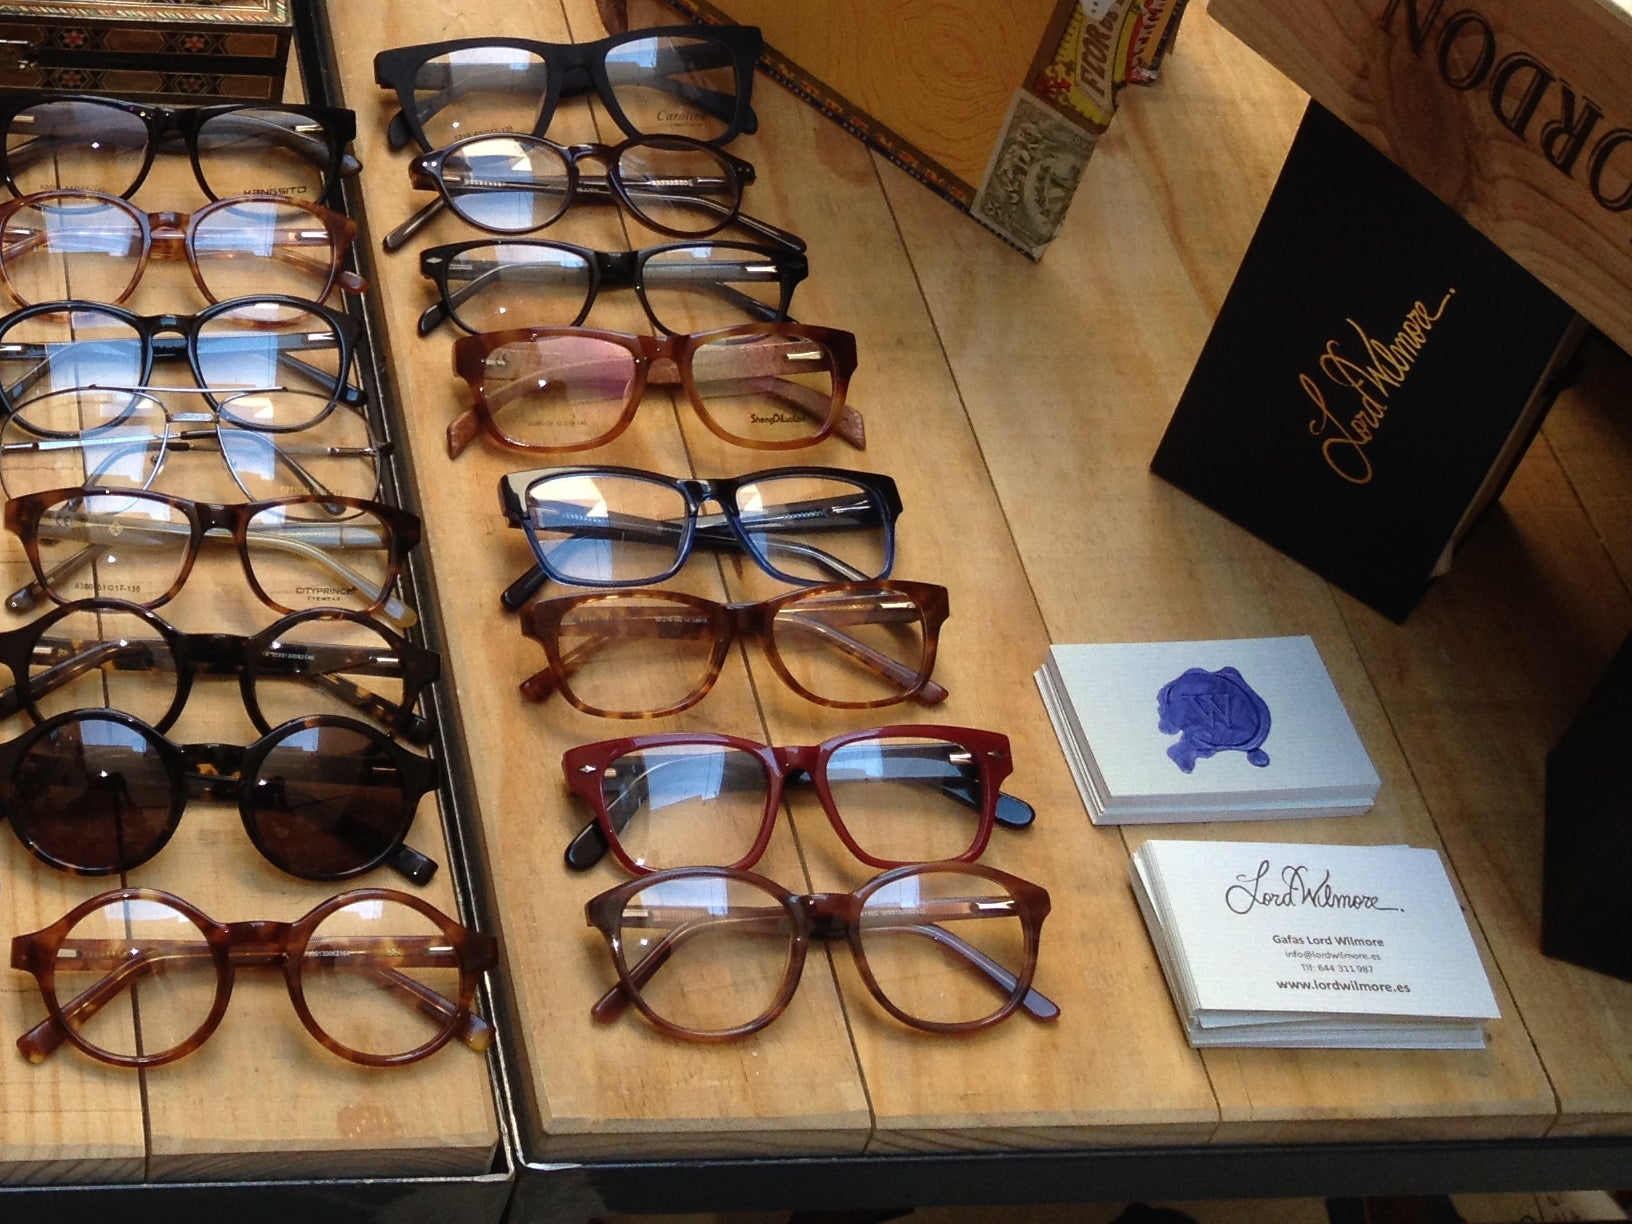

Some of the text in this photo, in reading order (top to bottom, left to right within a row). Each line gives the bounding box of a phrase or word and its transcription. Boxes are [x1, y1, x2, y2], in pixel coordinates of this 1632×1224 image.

[1272, 934, 1384, 947] Gafas Lord Wilmore
[1276, 979, 1411, 994] www.lordwilmore.es
